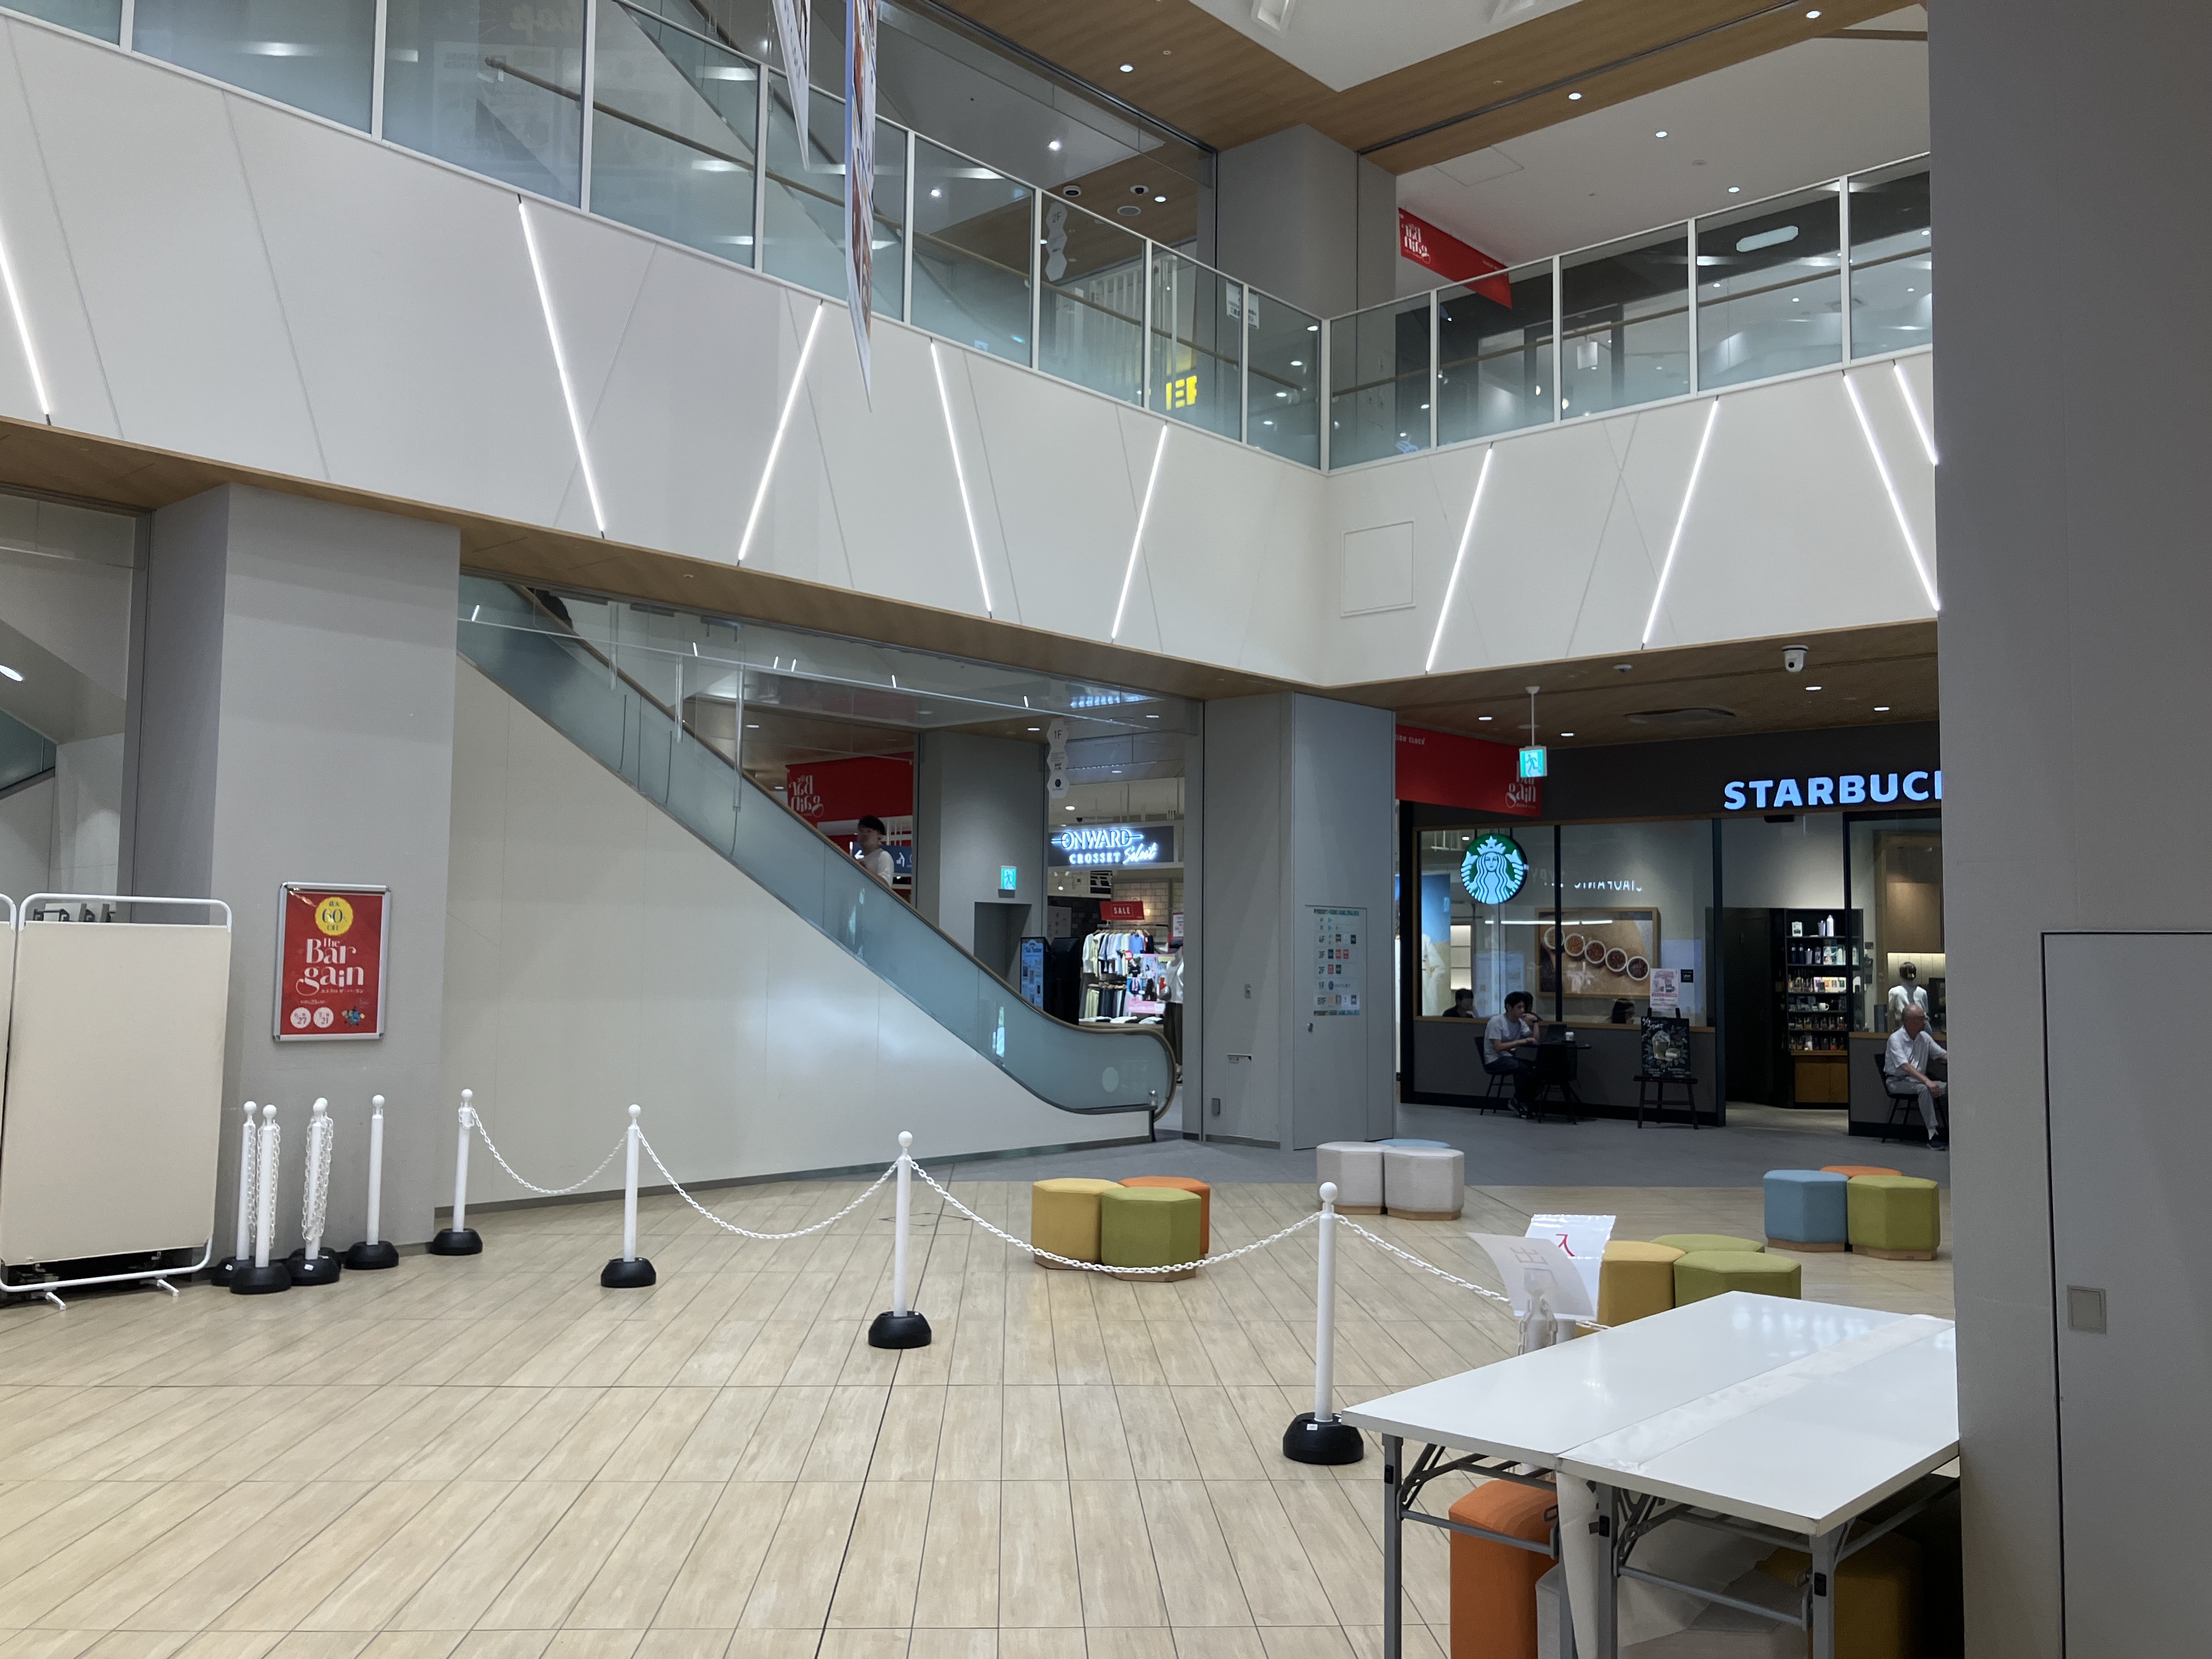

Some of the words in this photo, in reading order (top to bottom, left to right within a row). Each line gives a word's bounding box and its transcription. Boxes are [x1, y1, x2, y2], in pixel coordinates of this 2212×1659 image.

[1052, 211, 1061, 223] 2F
[1054, 730, 1063, 740] 1F
[1505, 782, 1536, 808] gain
[1062, 828, 1133, 850] ONWARD
[1069, 852, 1121, 865] CROSSET
[1122, 842, 1158, 865] Select
[1113, 906, 1131, 916] SALE
[306, 938, 357, 964] Bar
[323, 938, 341, 947] The
[1318, 966, 1325, 974] 2F
[295, 966, 364, 996] gain
[1317, 997, 1326, 1005] B1F
[1556, 1233, 1576, 1257] 入
